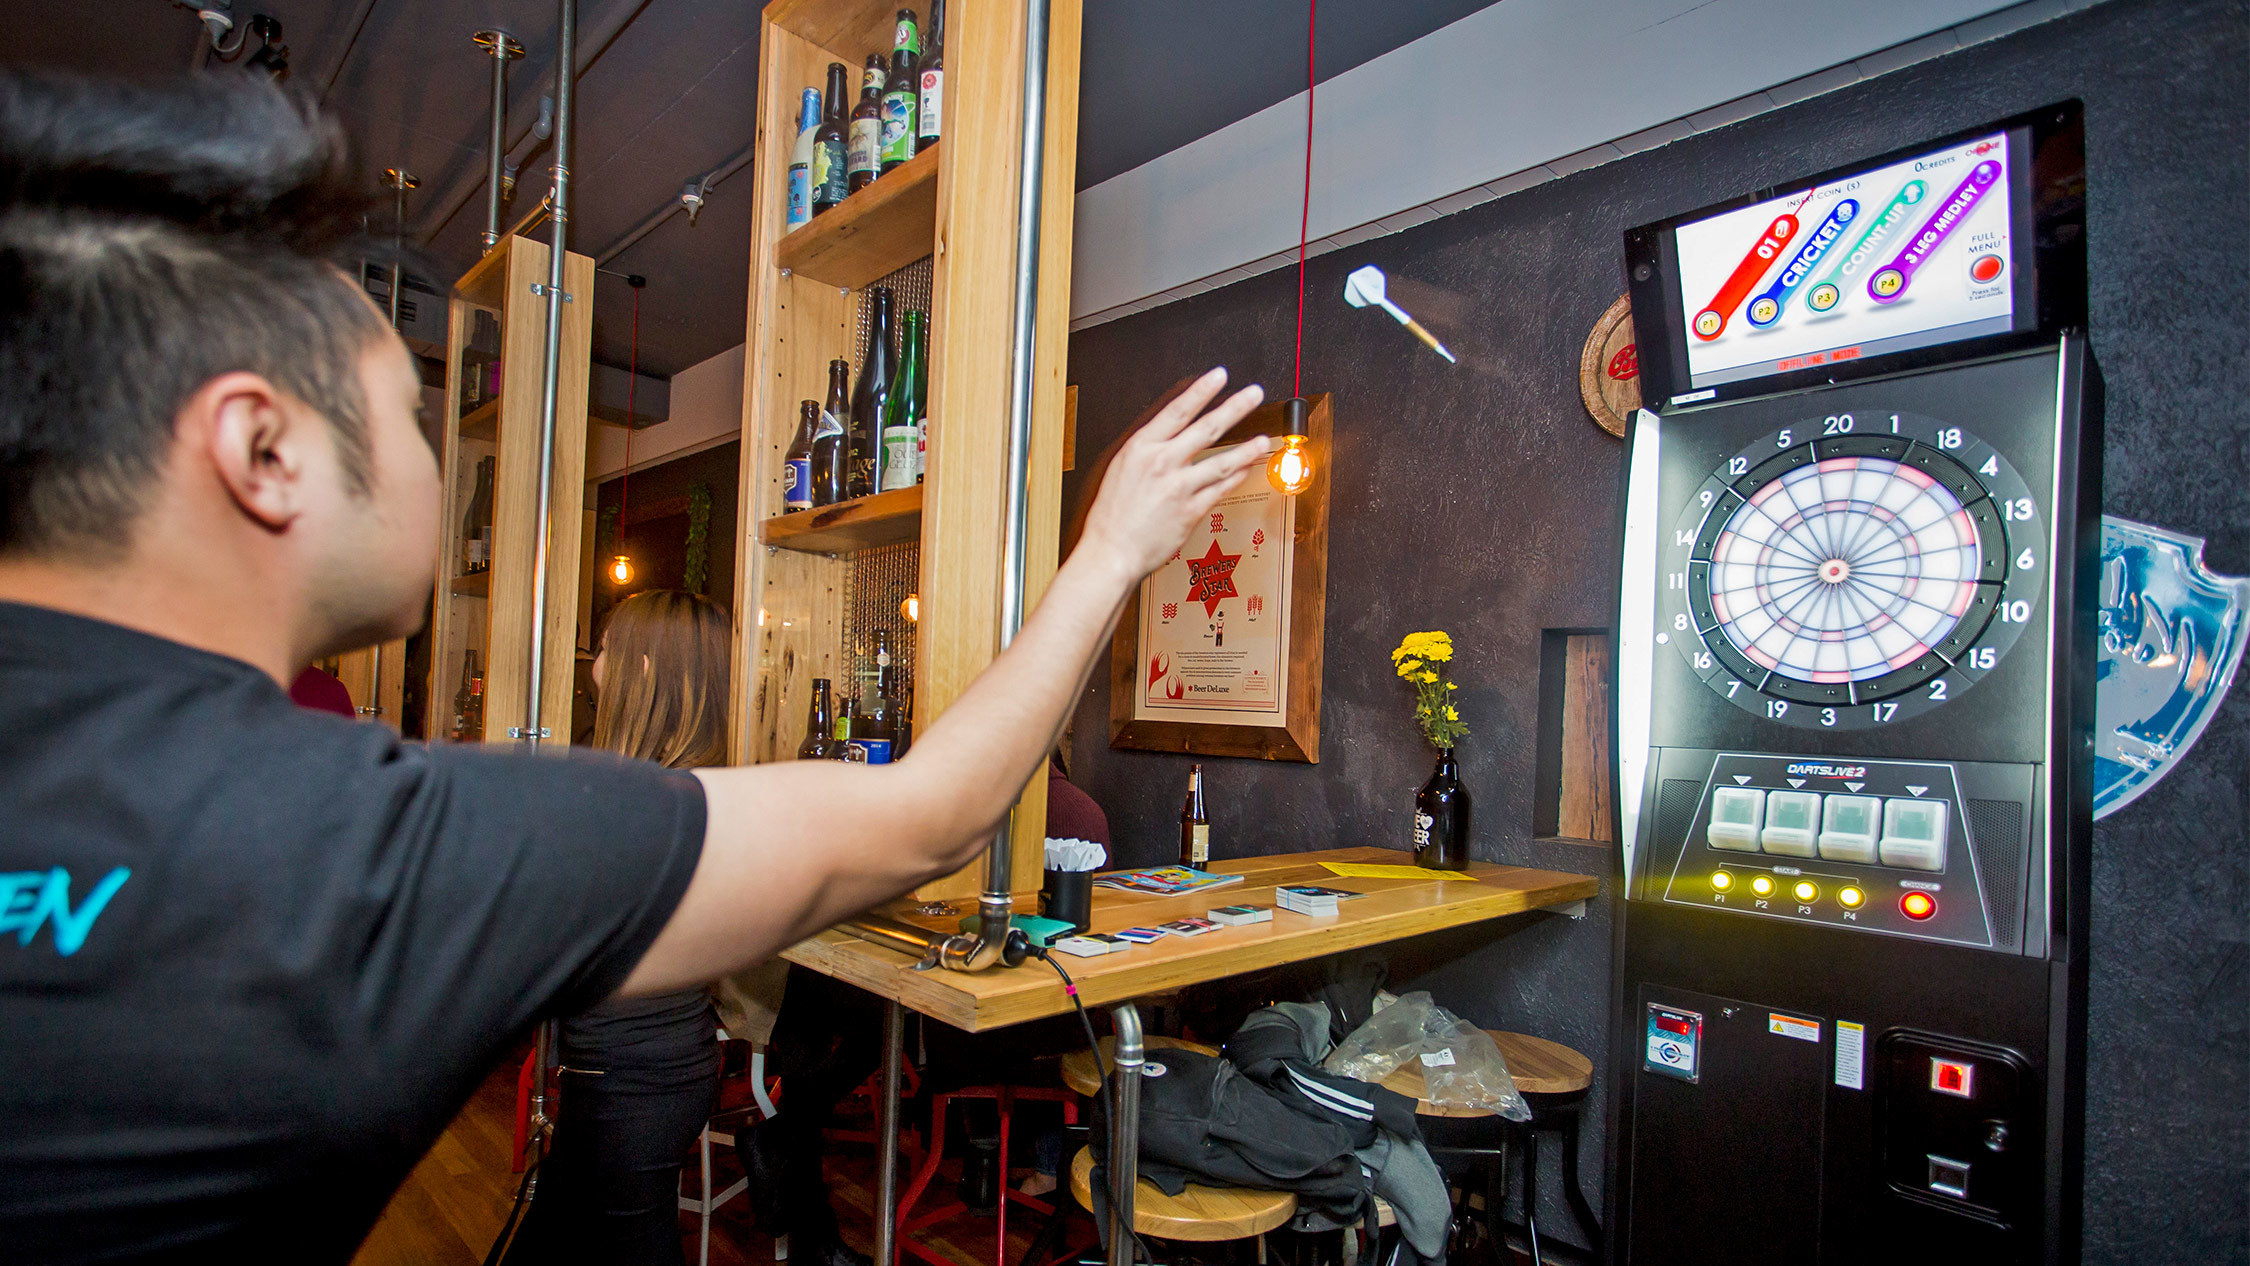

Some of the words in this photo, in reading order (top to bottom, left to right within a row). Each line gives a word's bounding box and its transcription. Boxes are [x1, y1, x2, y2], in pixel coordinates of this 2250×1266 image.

[1816, 187, 1842, 201] COIN
[1904, 252, 1918, 264] 3
[1912, 230, 1938, 255] LEG
[1933, 183, 1979, 232] MEDLEY
[1841, 201, 1906, 276] COUNT-UP
[1971, 231, 1996, 243] FULL
[1757, 237, 1780, 260] 01
[1782, 217, 1843, 287] CRICKET
[1967, 240, 2001, 254] MENU
[1881, 278, 1895, 290] P4
[1817, 293, 1831, 304] P3
[1758, 306, 1771, 317] P2
[1703, 319, 1714, 329] P1
[1823, 415, 1854, 435] 20
[1890, 415, 1898, 433] 1
[1777, 430, 1791, 447] 5
[1937, 429, 1962, 449] 18
[1728, 458, 1747, 475] 12
[1980, 456, 1998, 476] 4
[1699, 490, 1713, 508] 9
[2004, 500, 2033, 521] 13
[1676, 530, 1694, 546] 14
[2016, 548, 2034, 570] 6
[1200, 577, 1233, 602] STAR
[1669, 573, 1683, 589] 11
[2001, 601, 2029, 623] 10
[1674, 614, 1687, 630] 8
[1693, 652, 1711, 669] 16
[1969, 648, 1996, 669] 15
[1193, 685, 1207, 693] Beer
[1207, 685, 1230, 693] DeLuxe
[1727, 681, 1741, 698] 7
[1929, 679, 1946, 700] 2
[1767, 701, 1788, 718] 19
[1821, 708, 1836, 726] 3
[1874, 703, 1898, 722] 17
[1787, 764, 1866, 778] DARTSLIVE2
[1714, 894, 1725, 903] P1
[1755, 900, 1768, 909] P2
[1798, 905, 1811, 915] P3
[1843, 912, 1857, 921] P4
